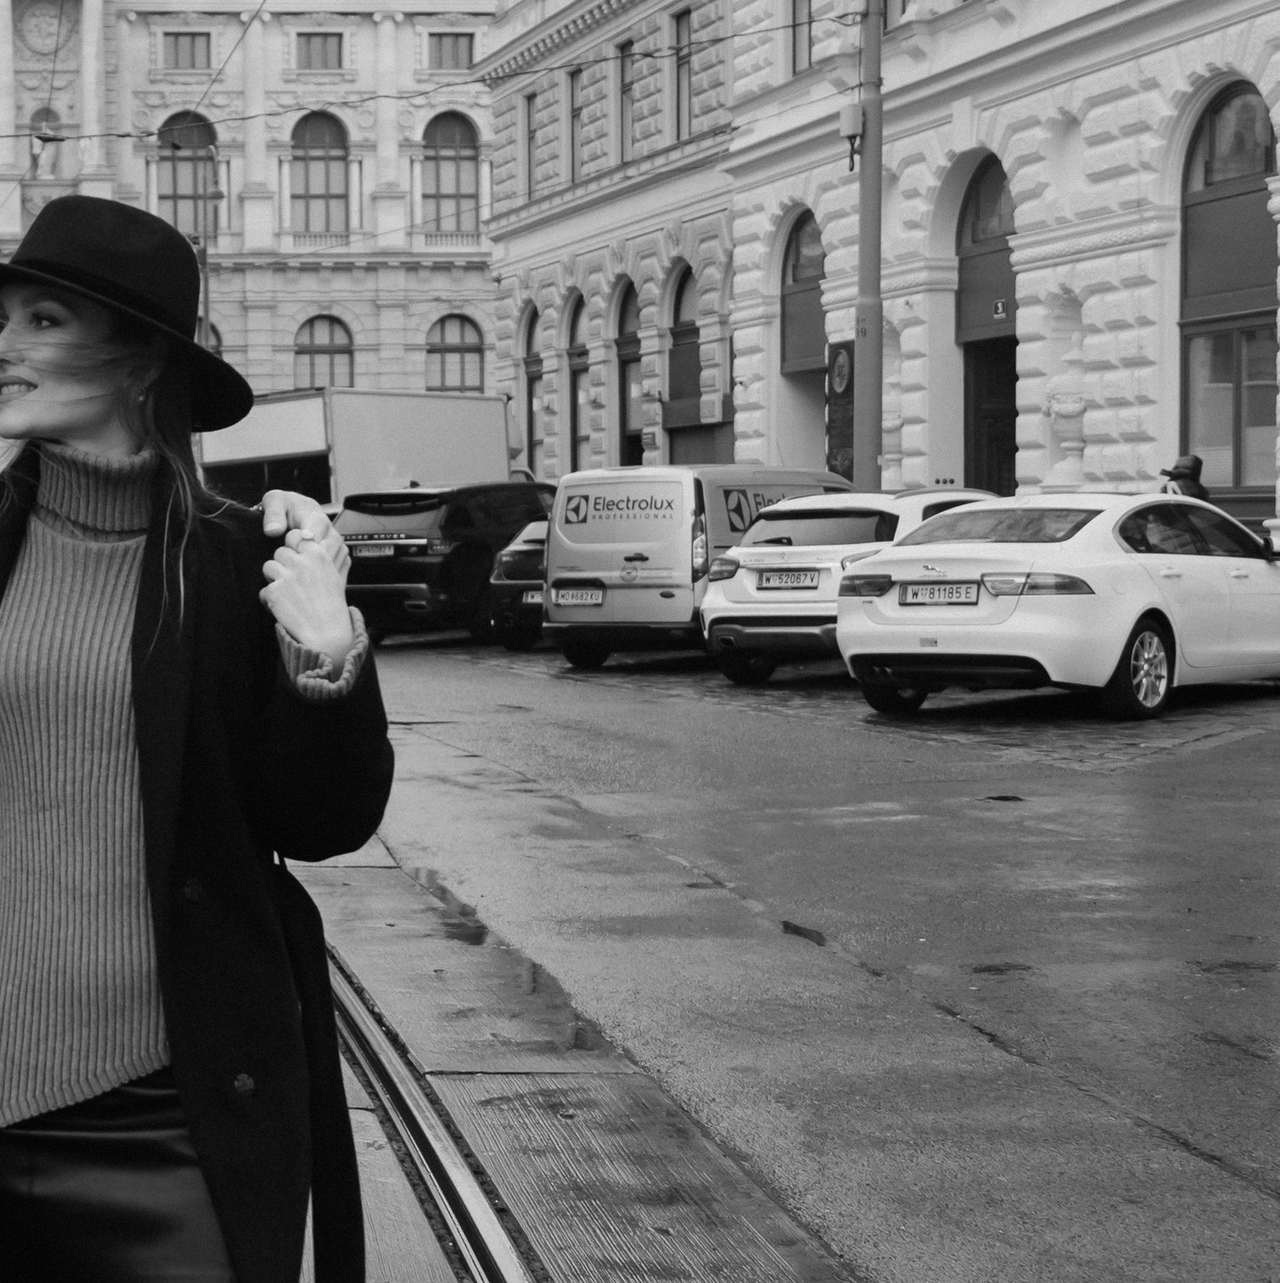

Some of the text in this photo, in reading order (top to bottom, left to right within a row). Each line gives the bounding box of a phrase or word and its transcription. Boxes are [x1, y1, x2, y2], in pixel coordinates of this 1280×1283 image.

[593, 495, 674, 511] Electrolux
[778, 573, 808, 584] 52067
[911, 586, 972, 600] W 81185 E
